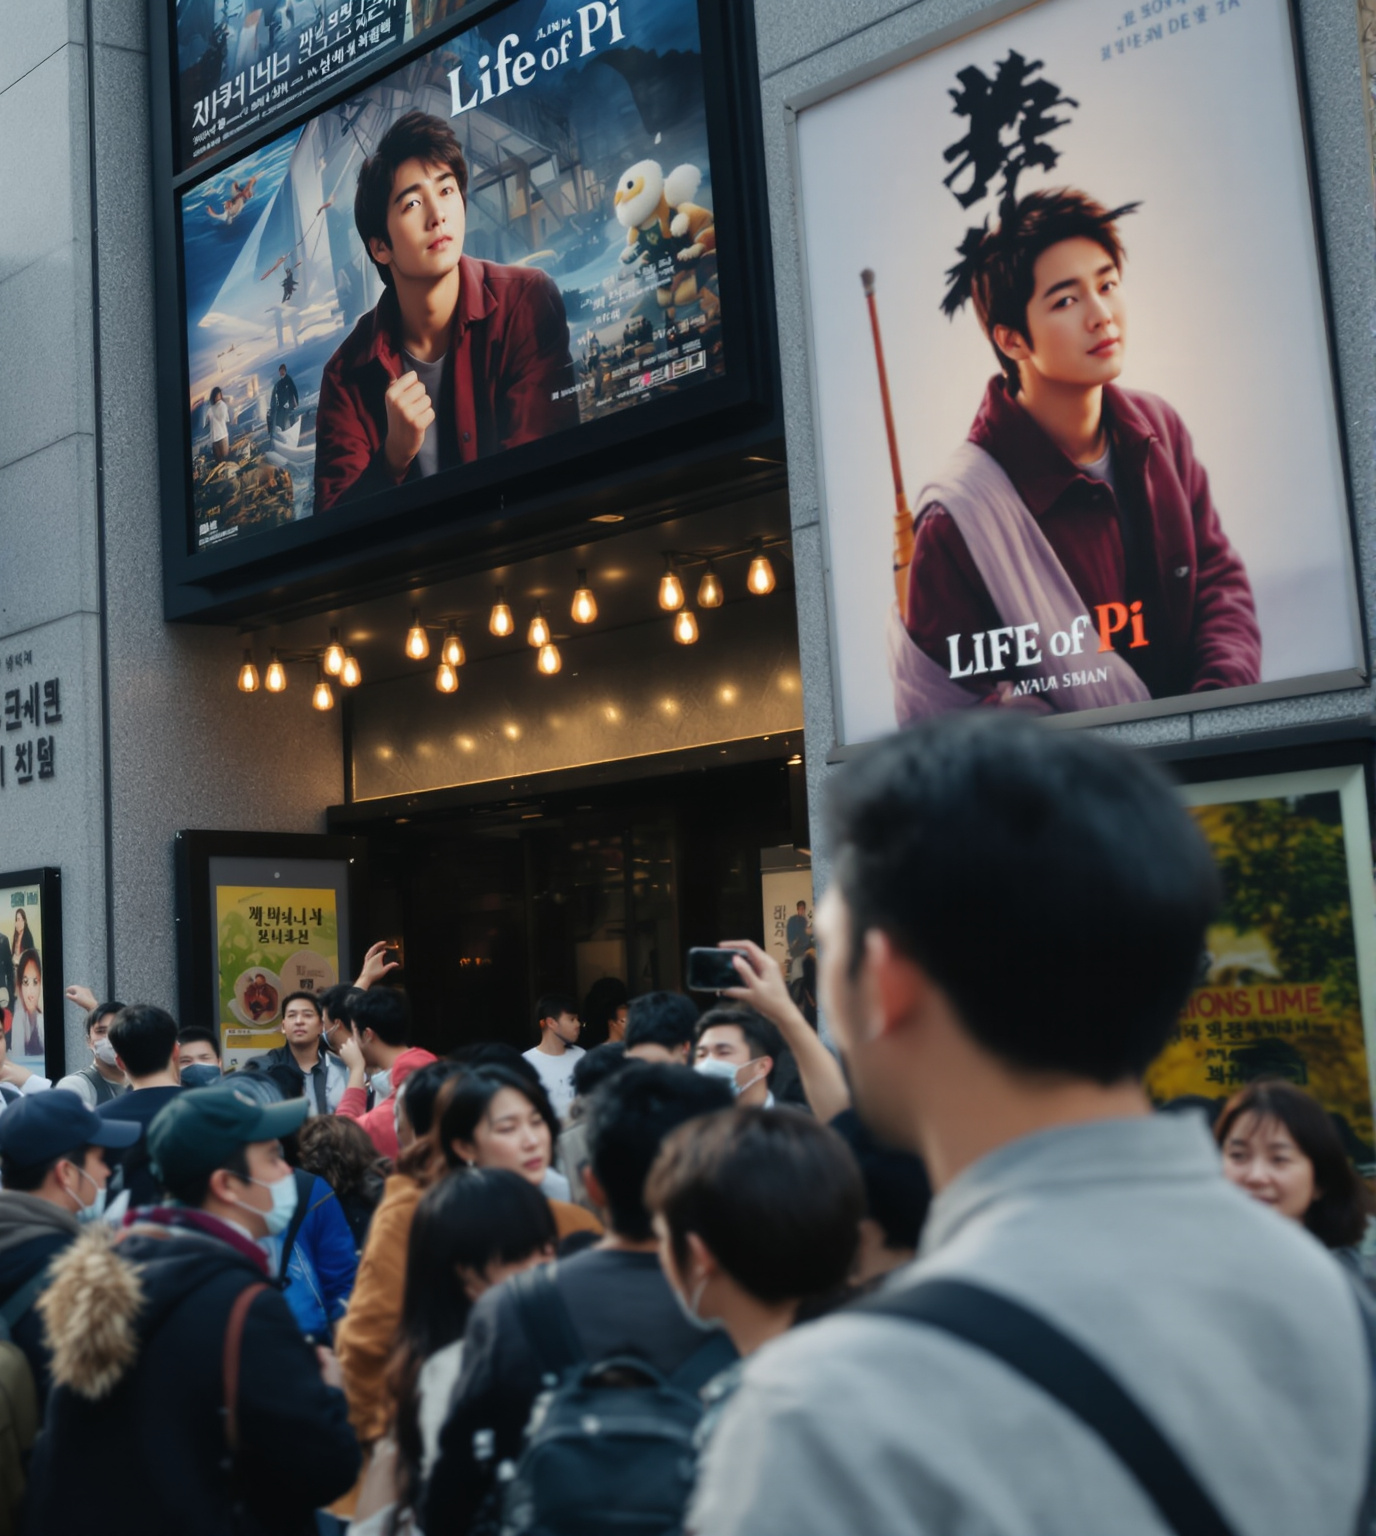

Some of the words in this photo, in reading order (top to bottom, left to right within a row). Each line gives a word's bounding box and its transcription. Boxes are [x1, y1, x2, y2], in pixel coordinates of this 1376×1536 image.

[447, 33, 536, 118] Life
[541, 29, 574, 71] of
[576, 0, 626, 57] Pi
[946, 622, 1042, 679] LIFE
[1050, 615, 1091, 657] of
[1094, 600, 1150, 654] Pi
[1258, 985, 1322, 1015] LIME
